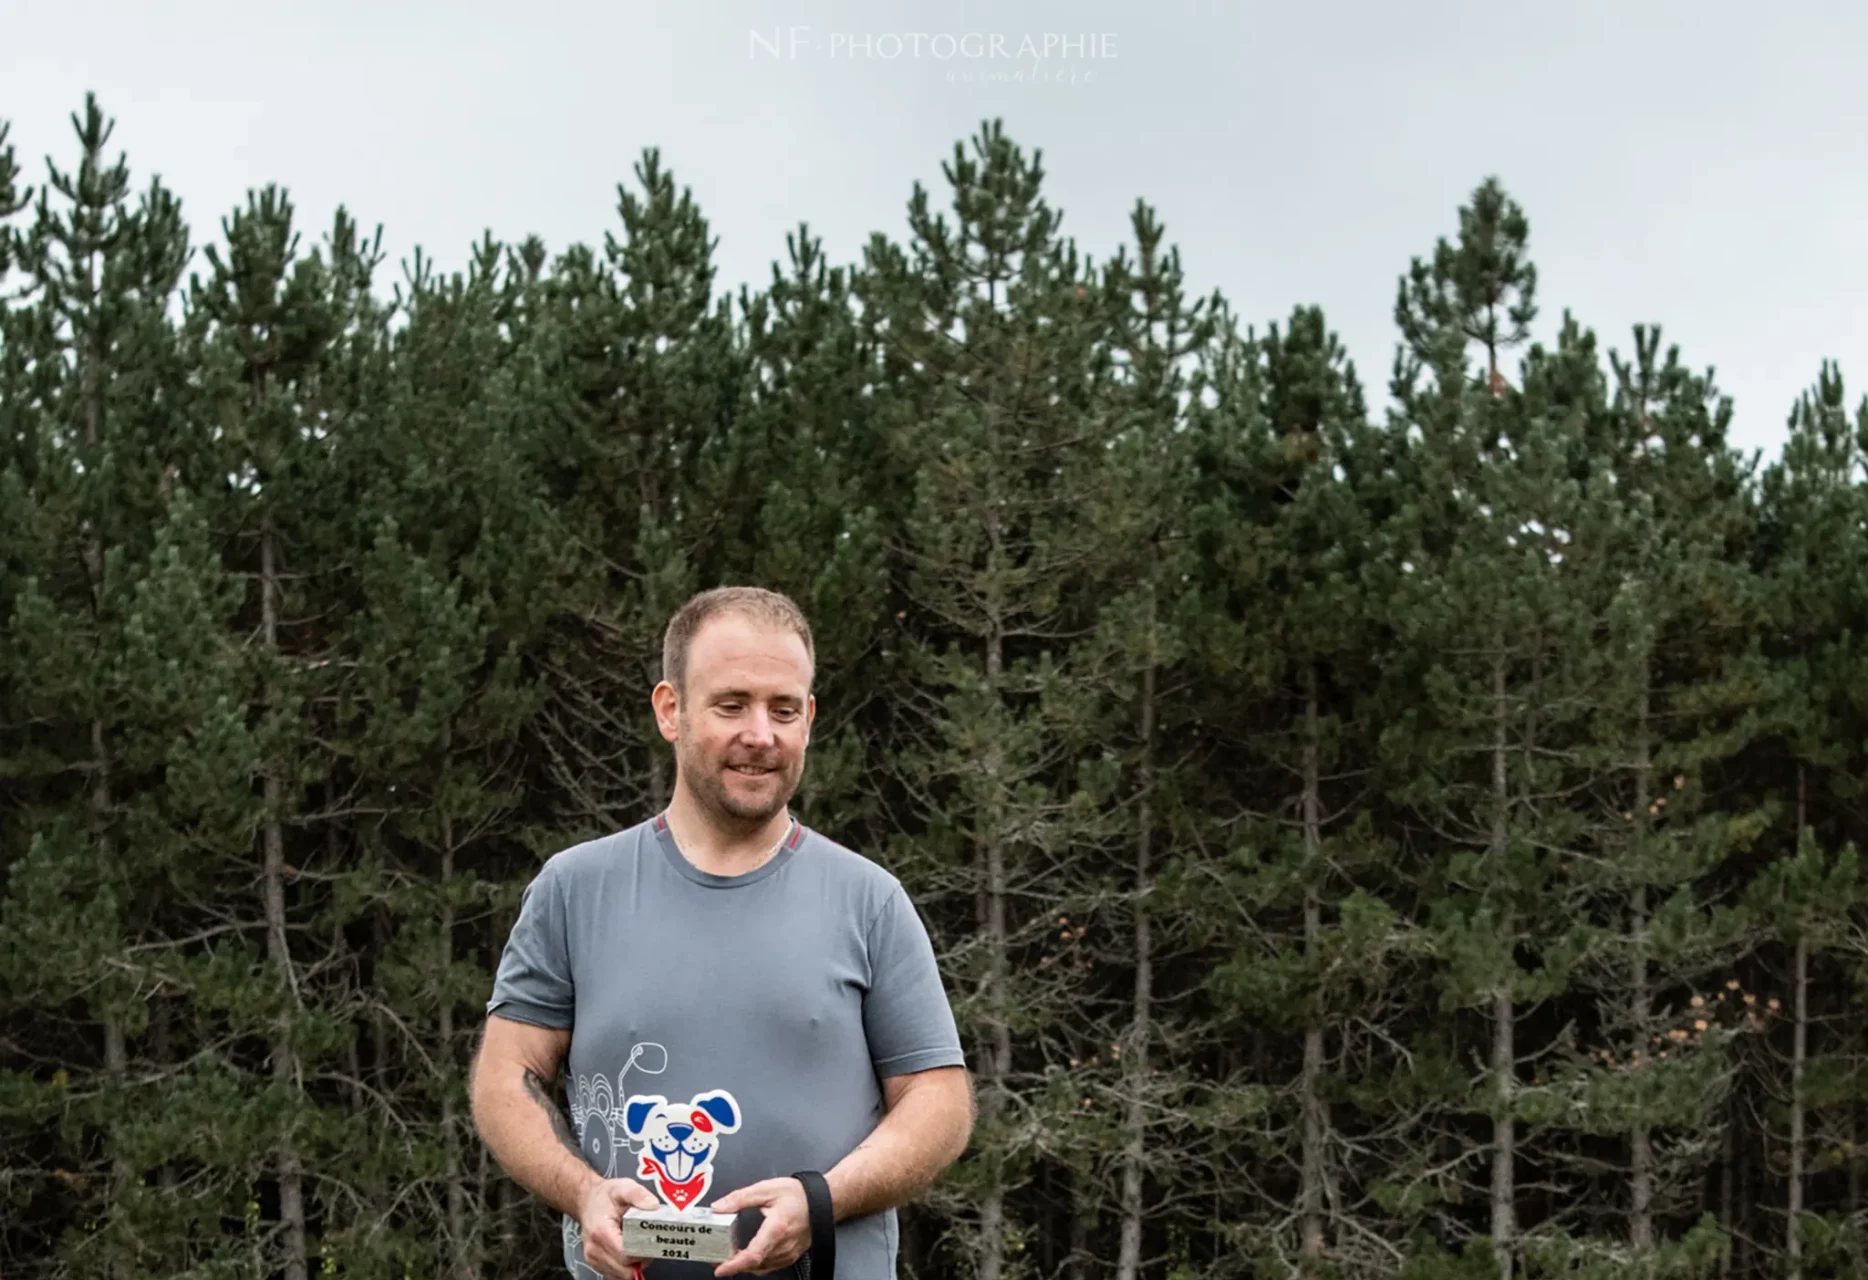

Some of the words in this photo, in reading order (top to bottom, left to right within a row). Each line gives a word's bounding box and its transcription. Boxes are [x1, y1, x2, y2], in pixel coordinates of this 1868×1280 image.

[640, 1221, 695, 1233] Concours
[698, 1226, 712, 1234] de
[656, 1235, 696, 1246] beauté
[662, 1249, 690, 1259] 2024
